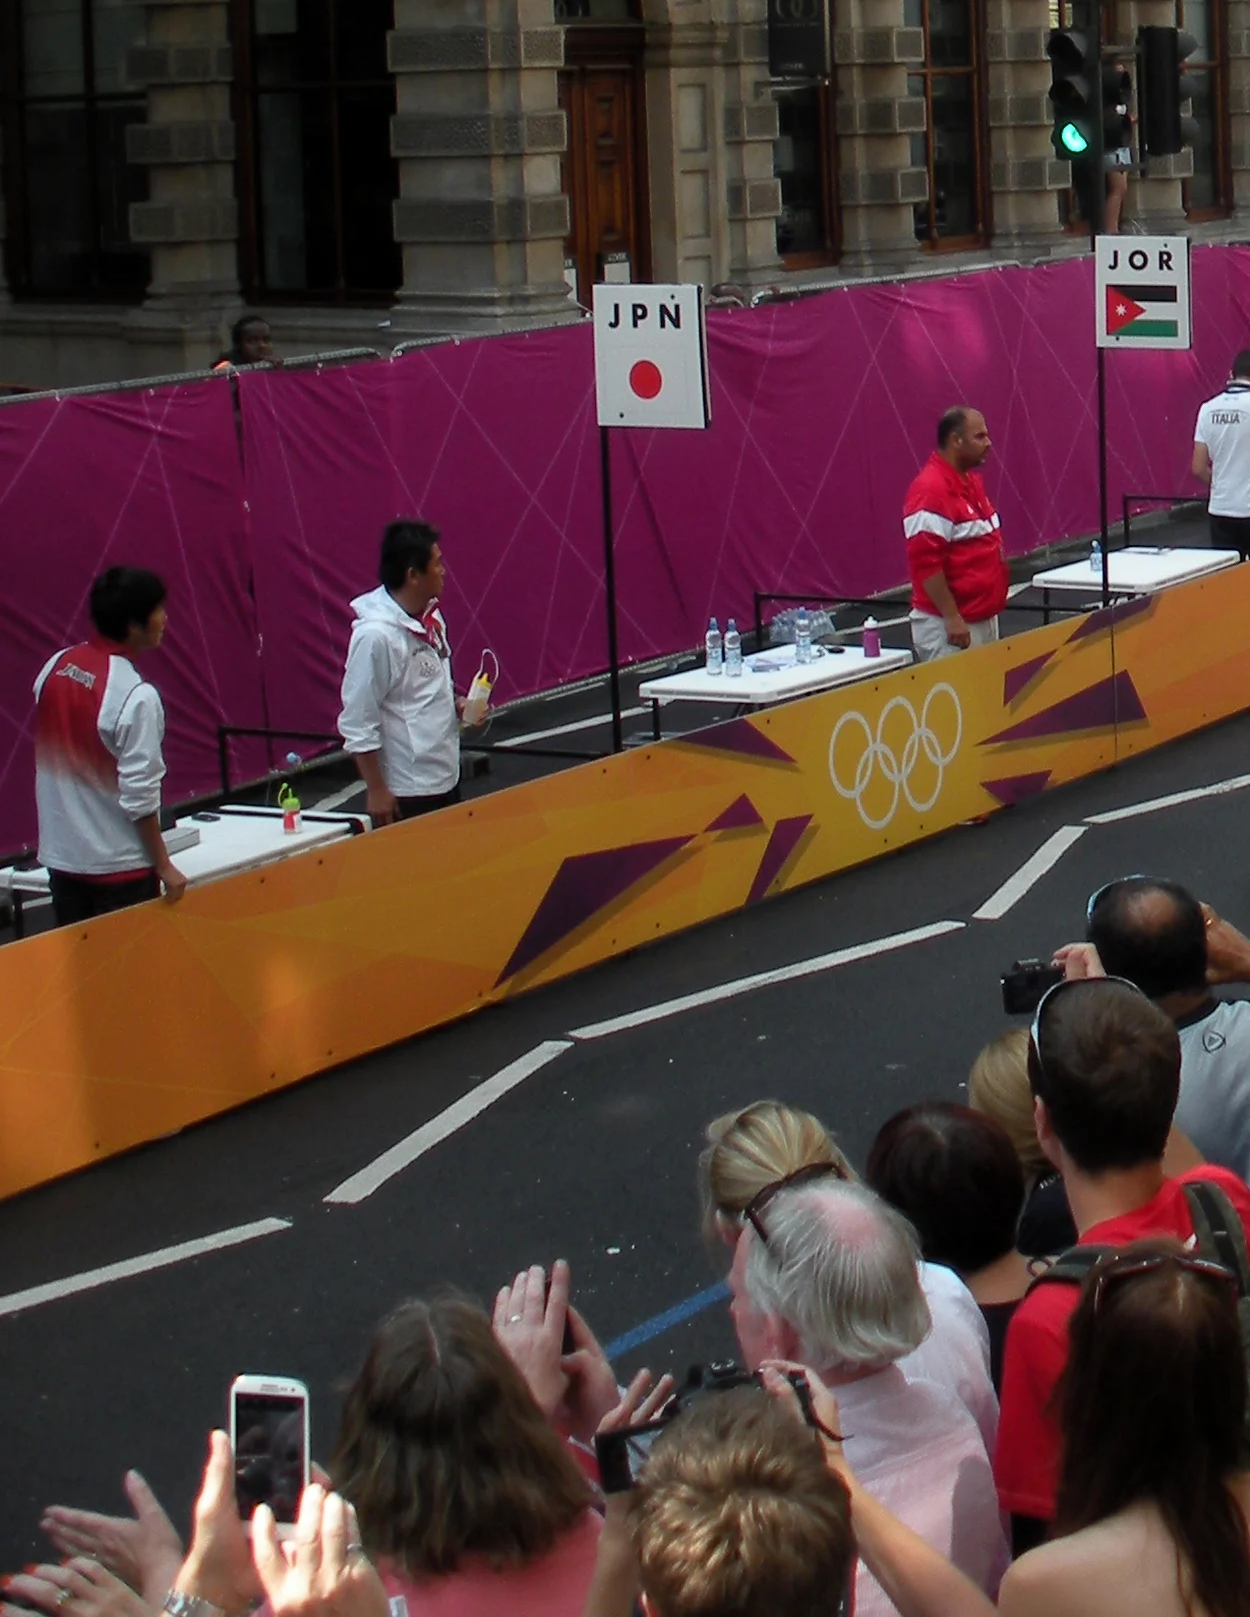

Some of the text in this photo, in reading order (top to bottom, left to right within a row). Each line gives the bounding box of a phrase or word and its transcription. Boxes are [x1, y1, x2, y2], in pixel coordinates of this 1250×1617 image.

[1107, 248, 1175, 272] JOR
[607, 302, 683, 329] JPN
[1211, 412, 1241, 424] ITALIA
